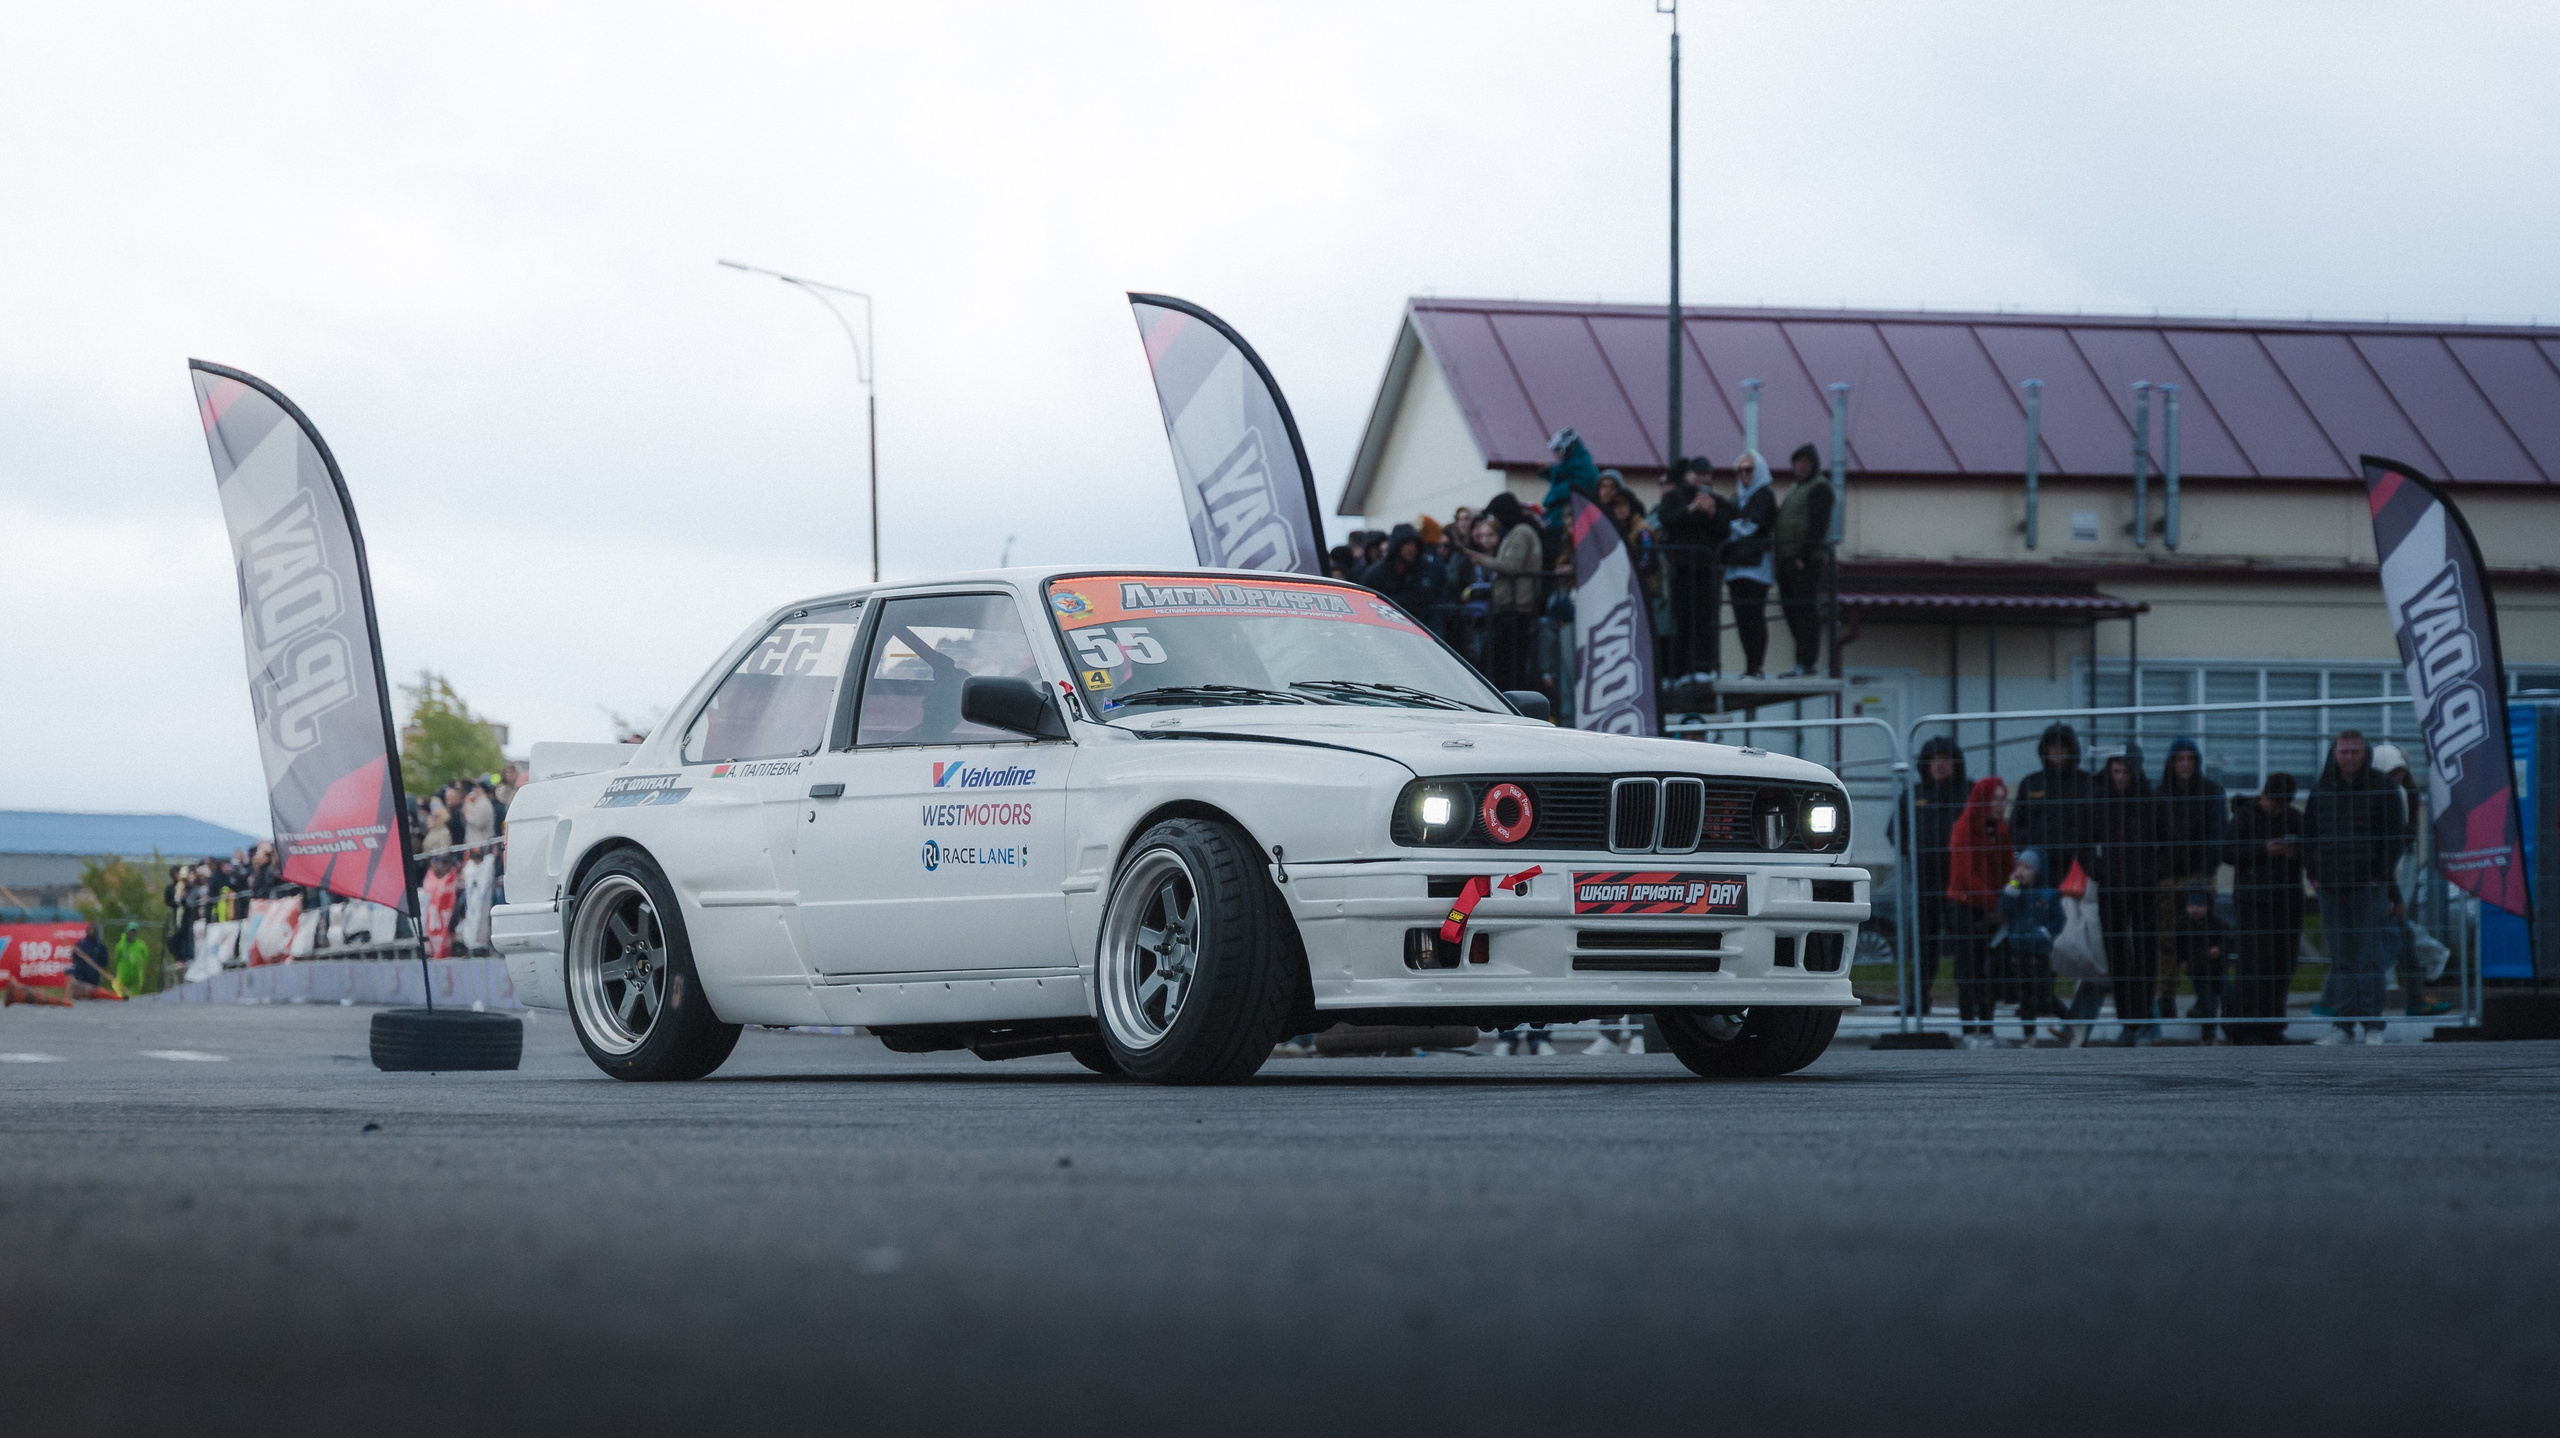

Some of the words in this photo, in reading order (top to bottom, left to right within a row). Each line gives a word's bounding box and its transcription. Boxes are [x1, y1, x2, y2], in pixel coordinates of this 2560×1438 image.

[1068, 626, 1168, 669] 55
[1090, 671, 1105, 684] 4
[726, 765, 737, 778] А.
[960, 764, 1036, 788] Valvoline
[607, 779, 628, 792] НА
[627, 776, 676, 791] ШИНАХ
[922, 802, 1032, 827] WESTMOTORS
[943, 847, 976, 864] RACE
[979, 847, 1015, 865] LANE
[1580, 884, 1629, 901] ШКОЛА
[1631, 884, 1685, 902] ДРИФТА
[1685, 883, 1706, 905] JP
[1707, 883, 1743, 906] DAY
